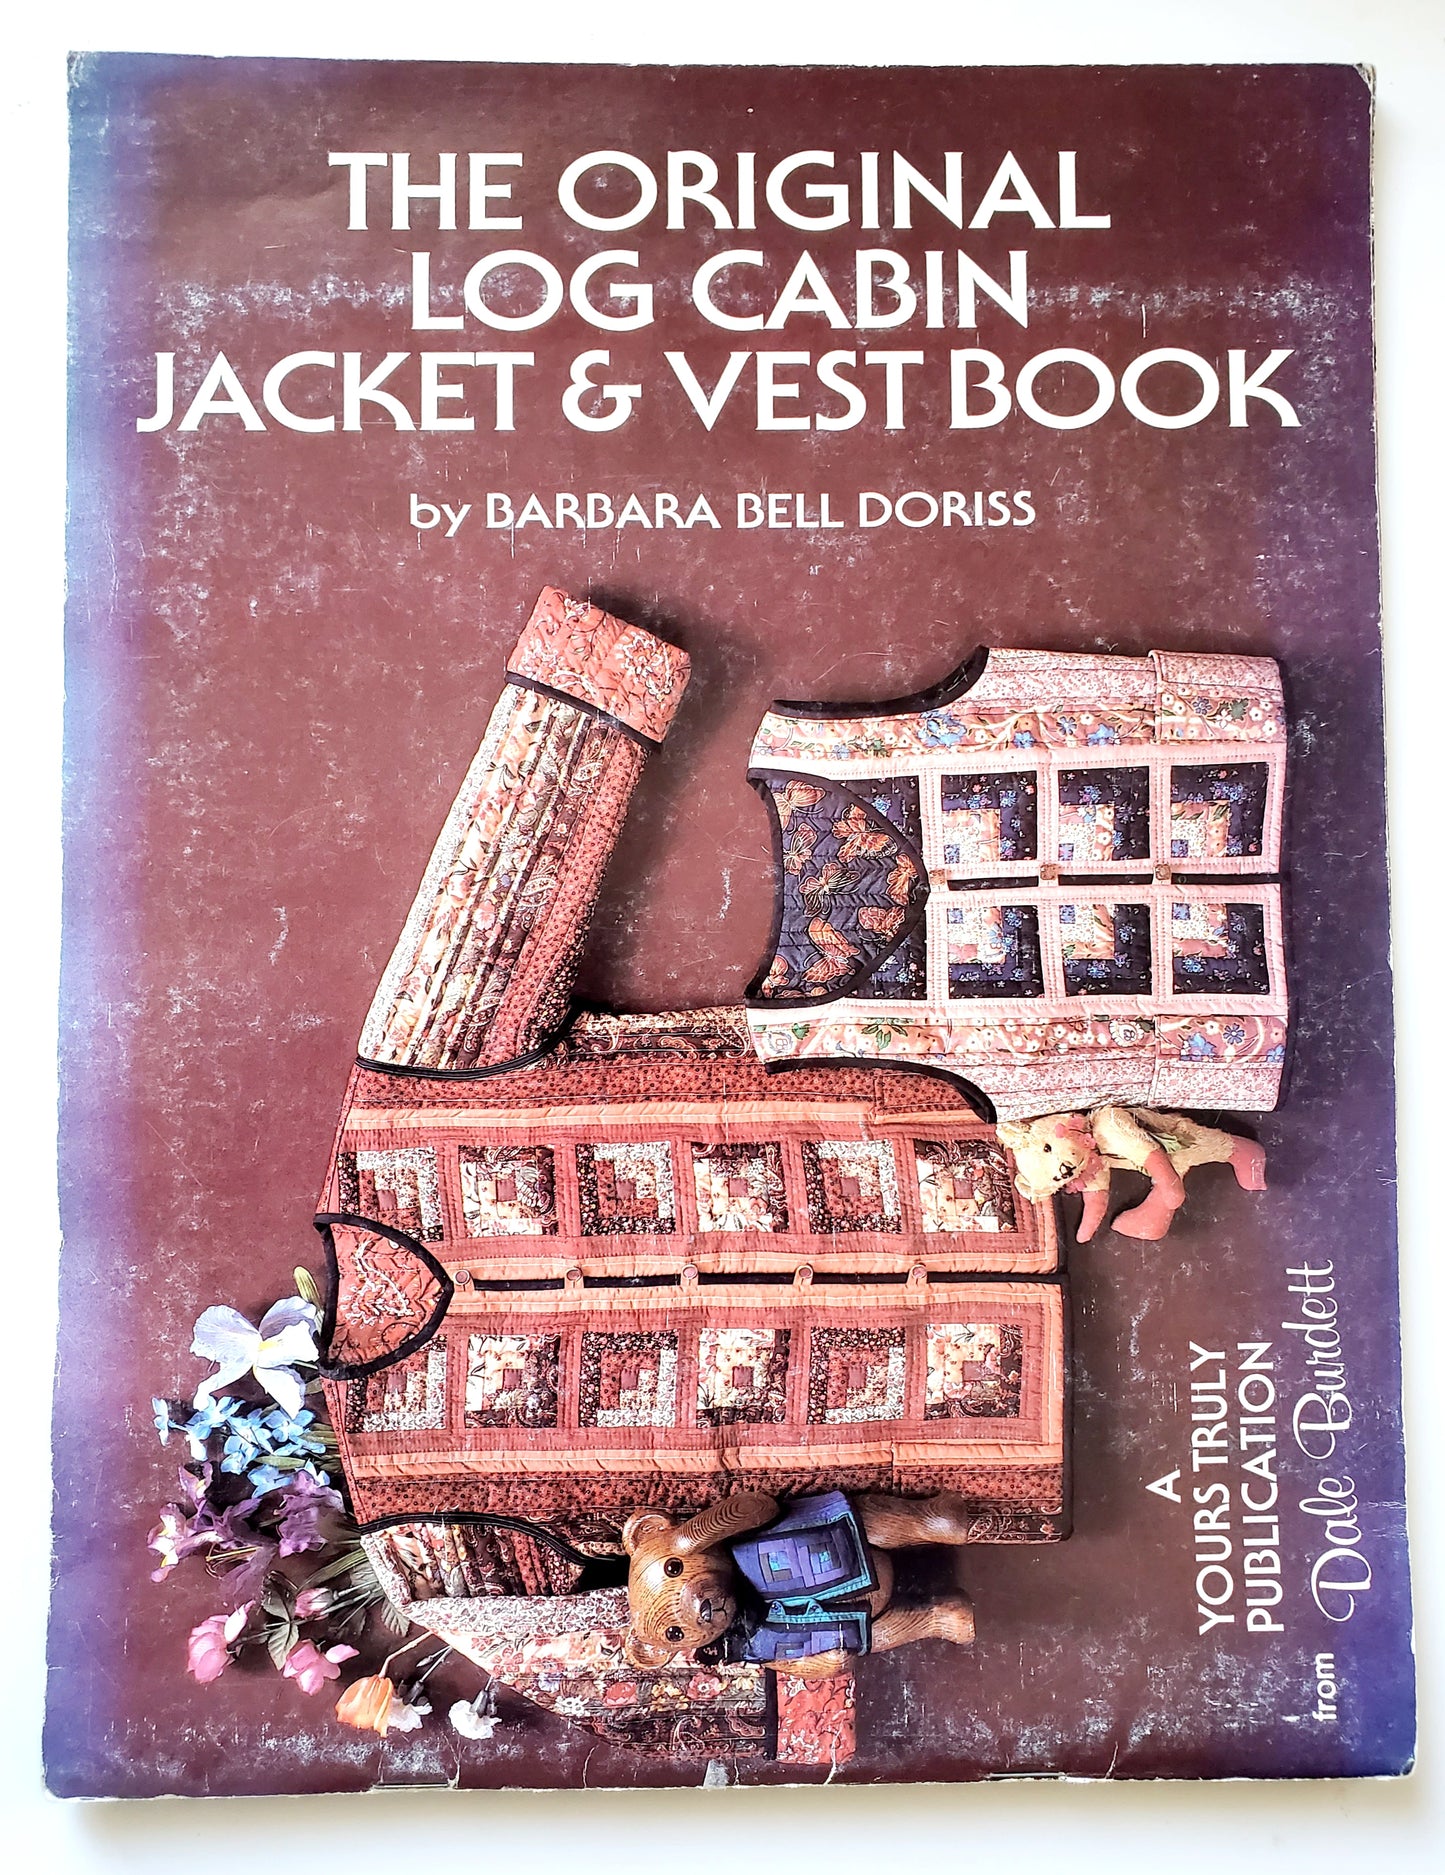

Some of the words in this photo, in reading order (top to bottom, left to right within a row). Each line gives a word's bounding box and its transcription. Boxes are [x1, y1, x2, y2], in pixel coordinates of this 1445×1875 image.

[328, 152, 524, 231] THE
[558, 150, 1112, 231] ORIGINAL
[411, 249, 656, 332] LOG
[691, 248, 1029, 332] CABIN
[136, 350, 536, 434] JACKET
[562, 349, 643, 432] &
[664, 350, 925, 432] VEST
[949, 347, 1302, 431] BOOK
[410, 493, 472, 538] by
[486, 492, 722, 531] BARBARA
[737, 492, 845, 530] BELL
[859, 490, 1036, 529] DORISS
[1279, 1258, 1354, 1461] Burdett
[1189, 1340, 1229, 1472] TRULY
[1145, 1469, 1182, 1503] A
[1237, 1341, 1285, 1634] PUBLICATION
[1193, 1482, 1233, 1636] YOURS
[1299, 1474, 1372, 1623] Dale
[1312, 1653, 1338, 1722] from
